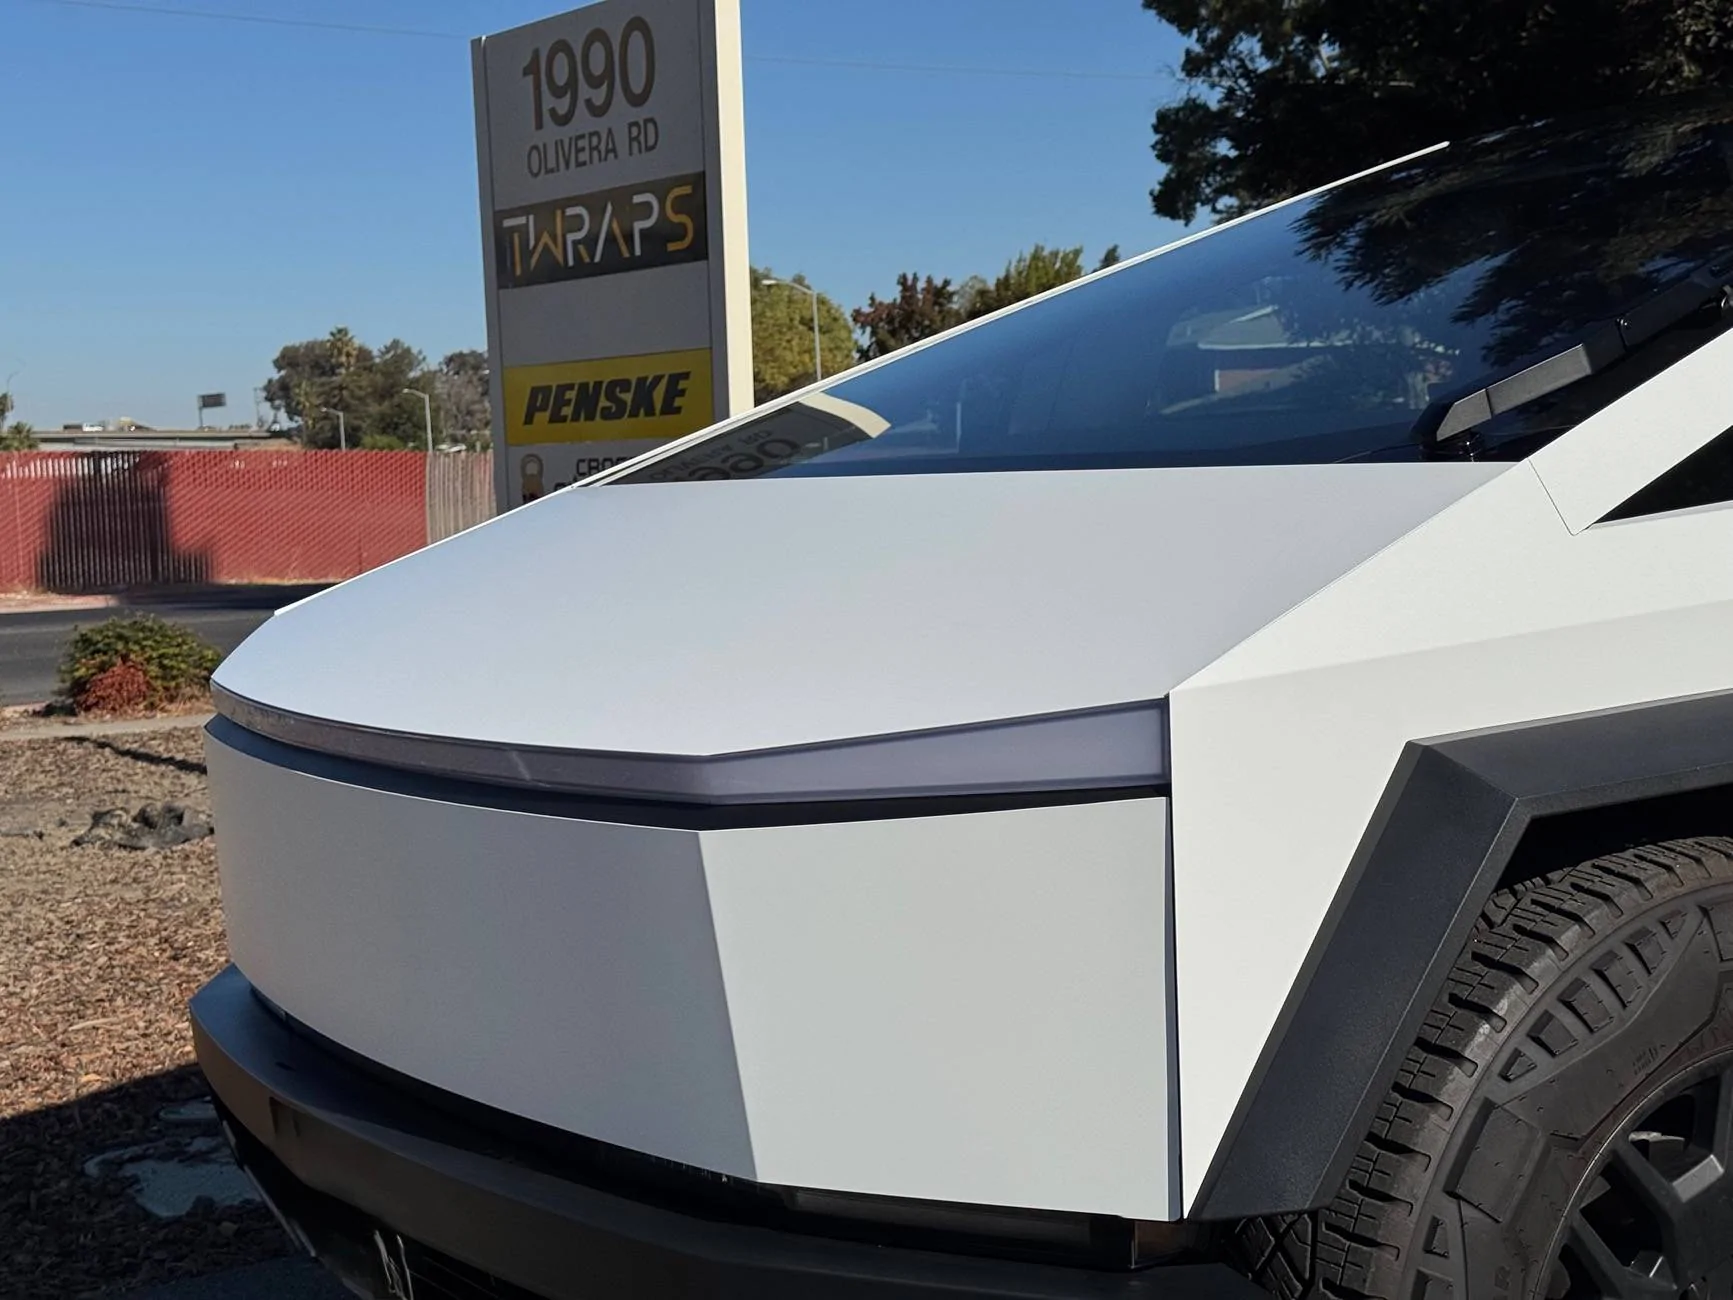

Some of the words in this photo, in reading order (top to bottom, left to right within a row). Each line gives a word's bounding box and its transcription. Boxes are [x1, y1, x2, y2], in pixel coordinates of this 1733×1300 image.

[522, 16, 655, 131] 1990
[527, 127, 618, 178] OLIVERA
[627, 117, 660, 156] RD
[503, 185, 694, 276] TWRAPS
[523, 371, 691, 426] PENSKE
